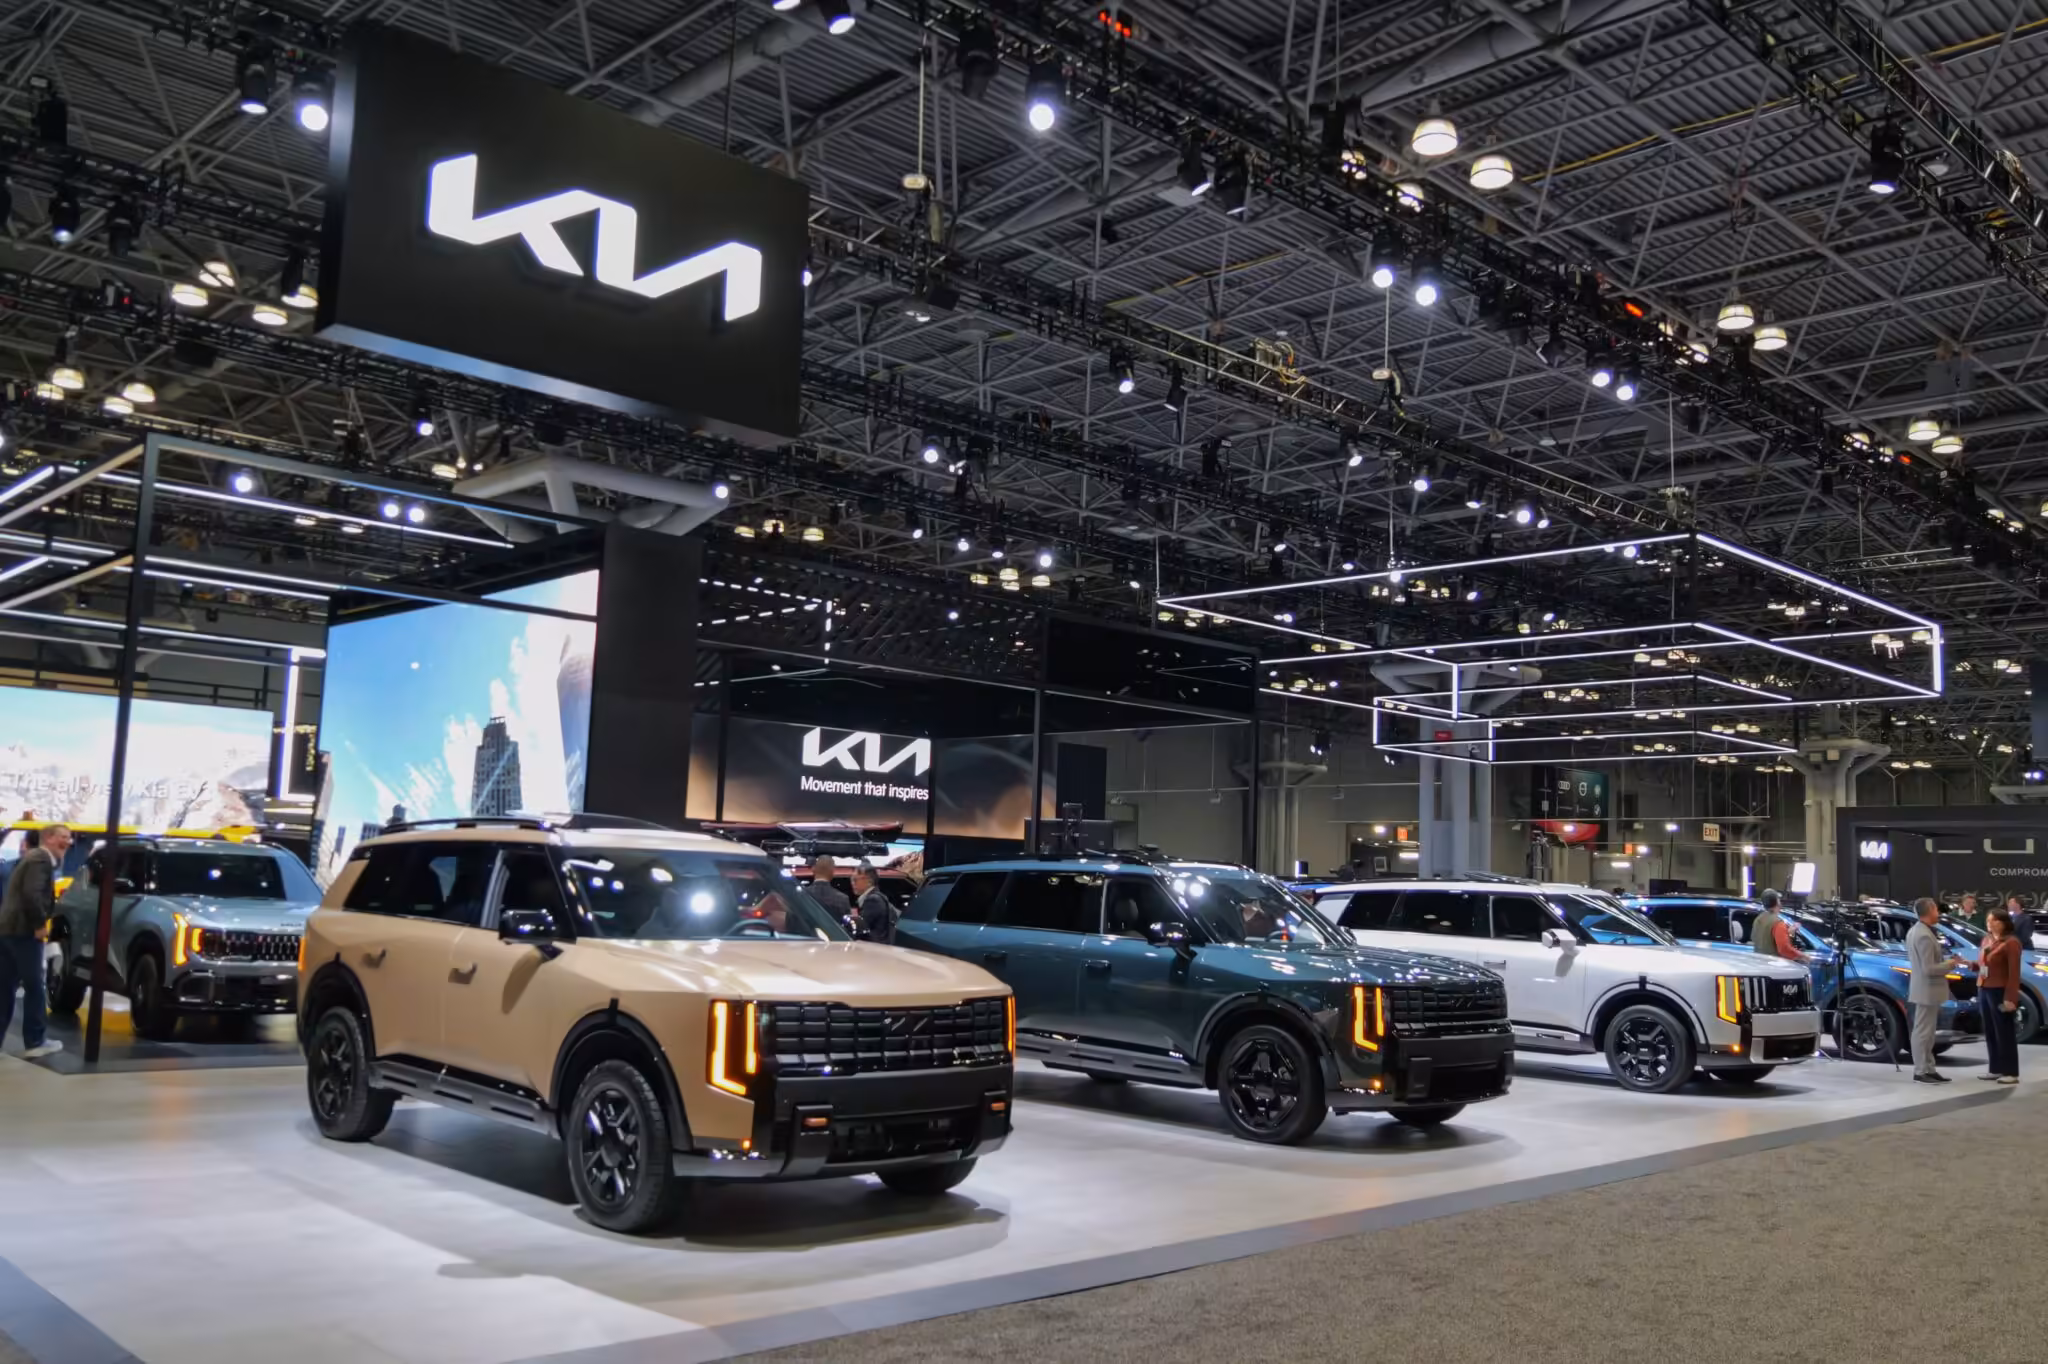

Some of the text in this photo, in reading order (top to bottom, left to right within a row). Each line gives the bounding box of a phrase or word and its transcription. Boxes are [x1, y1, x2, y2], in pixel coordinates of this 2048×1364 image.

[427, 153, 763, 322] KIA
[802, 726, 931, 776] KIA
[801, 776, 929, 801] Movement that inspires
[1704, 827, 1718, 838] EXIT
[1925, 838, 2048, 854] LU
[1989, 867, 2048, 877] COMPROM
